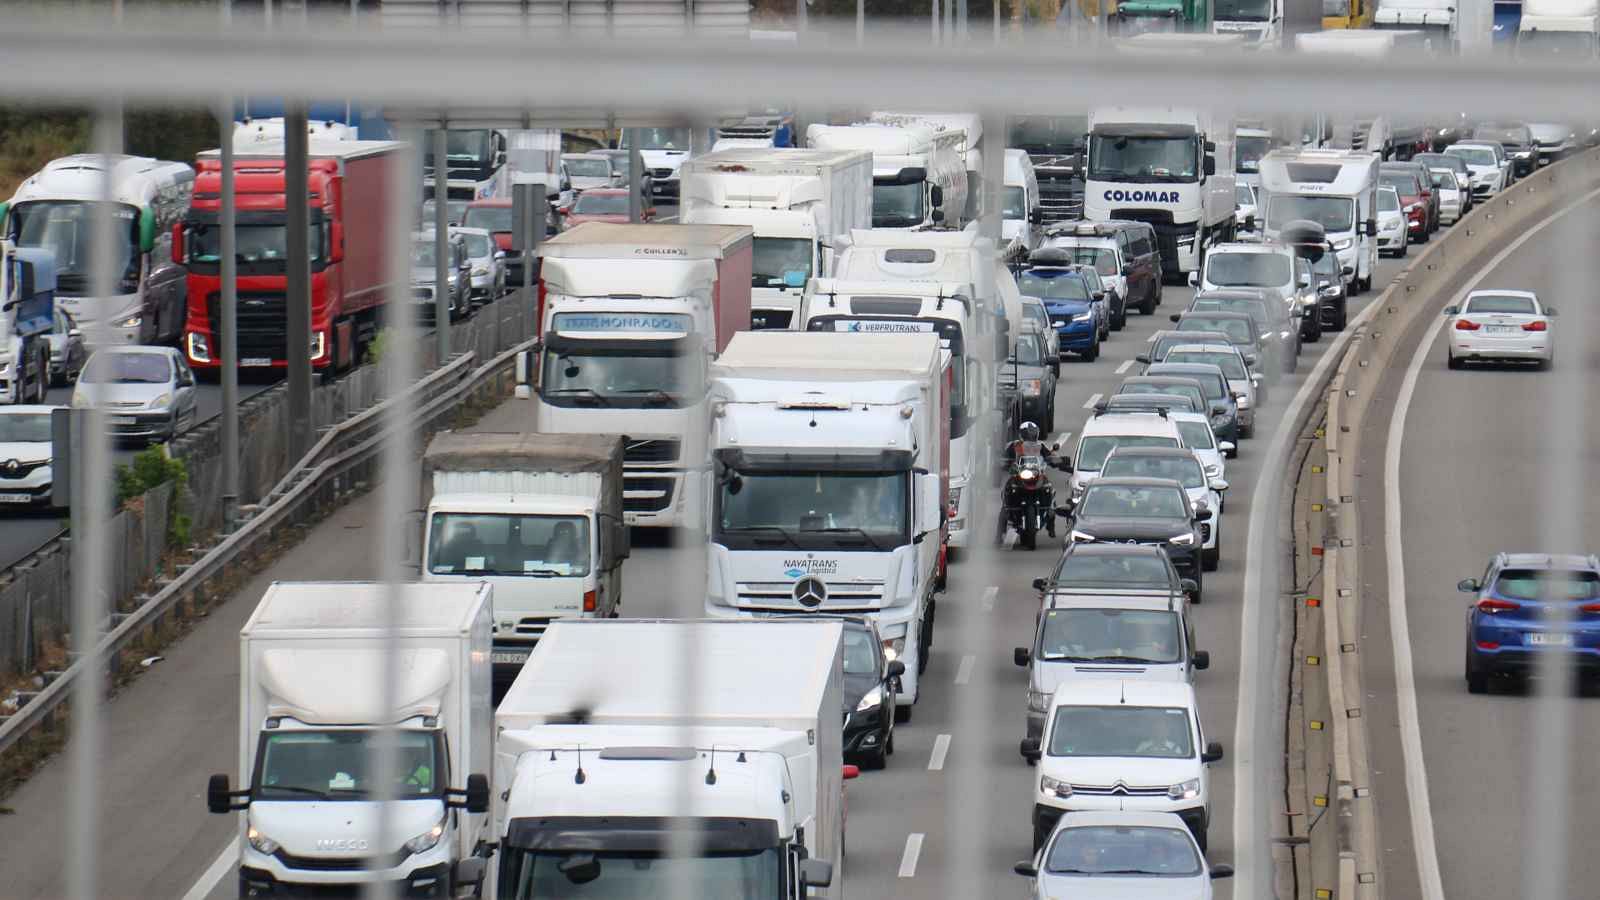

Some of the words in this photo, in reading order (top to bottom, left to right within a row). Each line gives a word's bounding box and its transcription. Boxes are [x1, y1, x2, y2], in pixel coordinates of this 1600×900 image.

[1103, 190, 1180, 203] COLOMAR
[783, 559, 838, 568] NAYATRANS
[316, 839, 369, 849] IVECO
